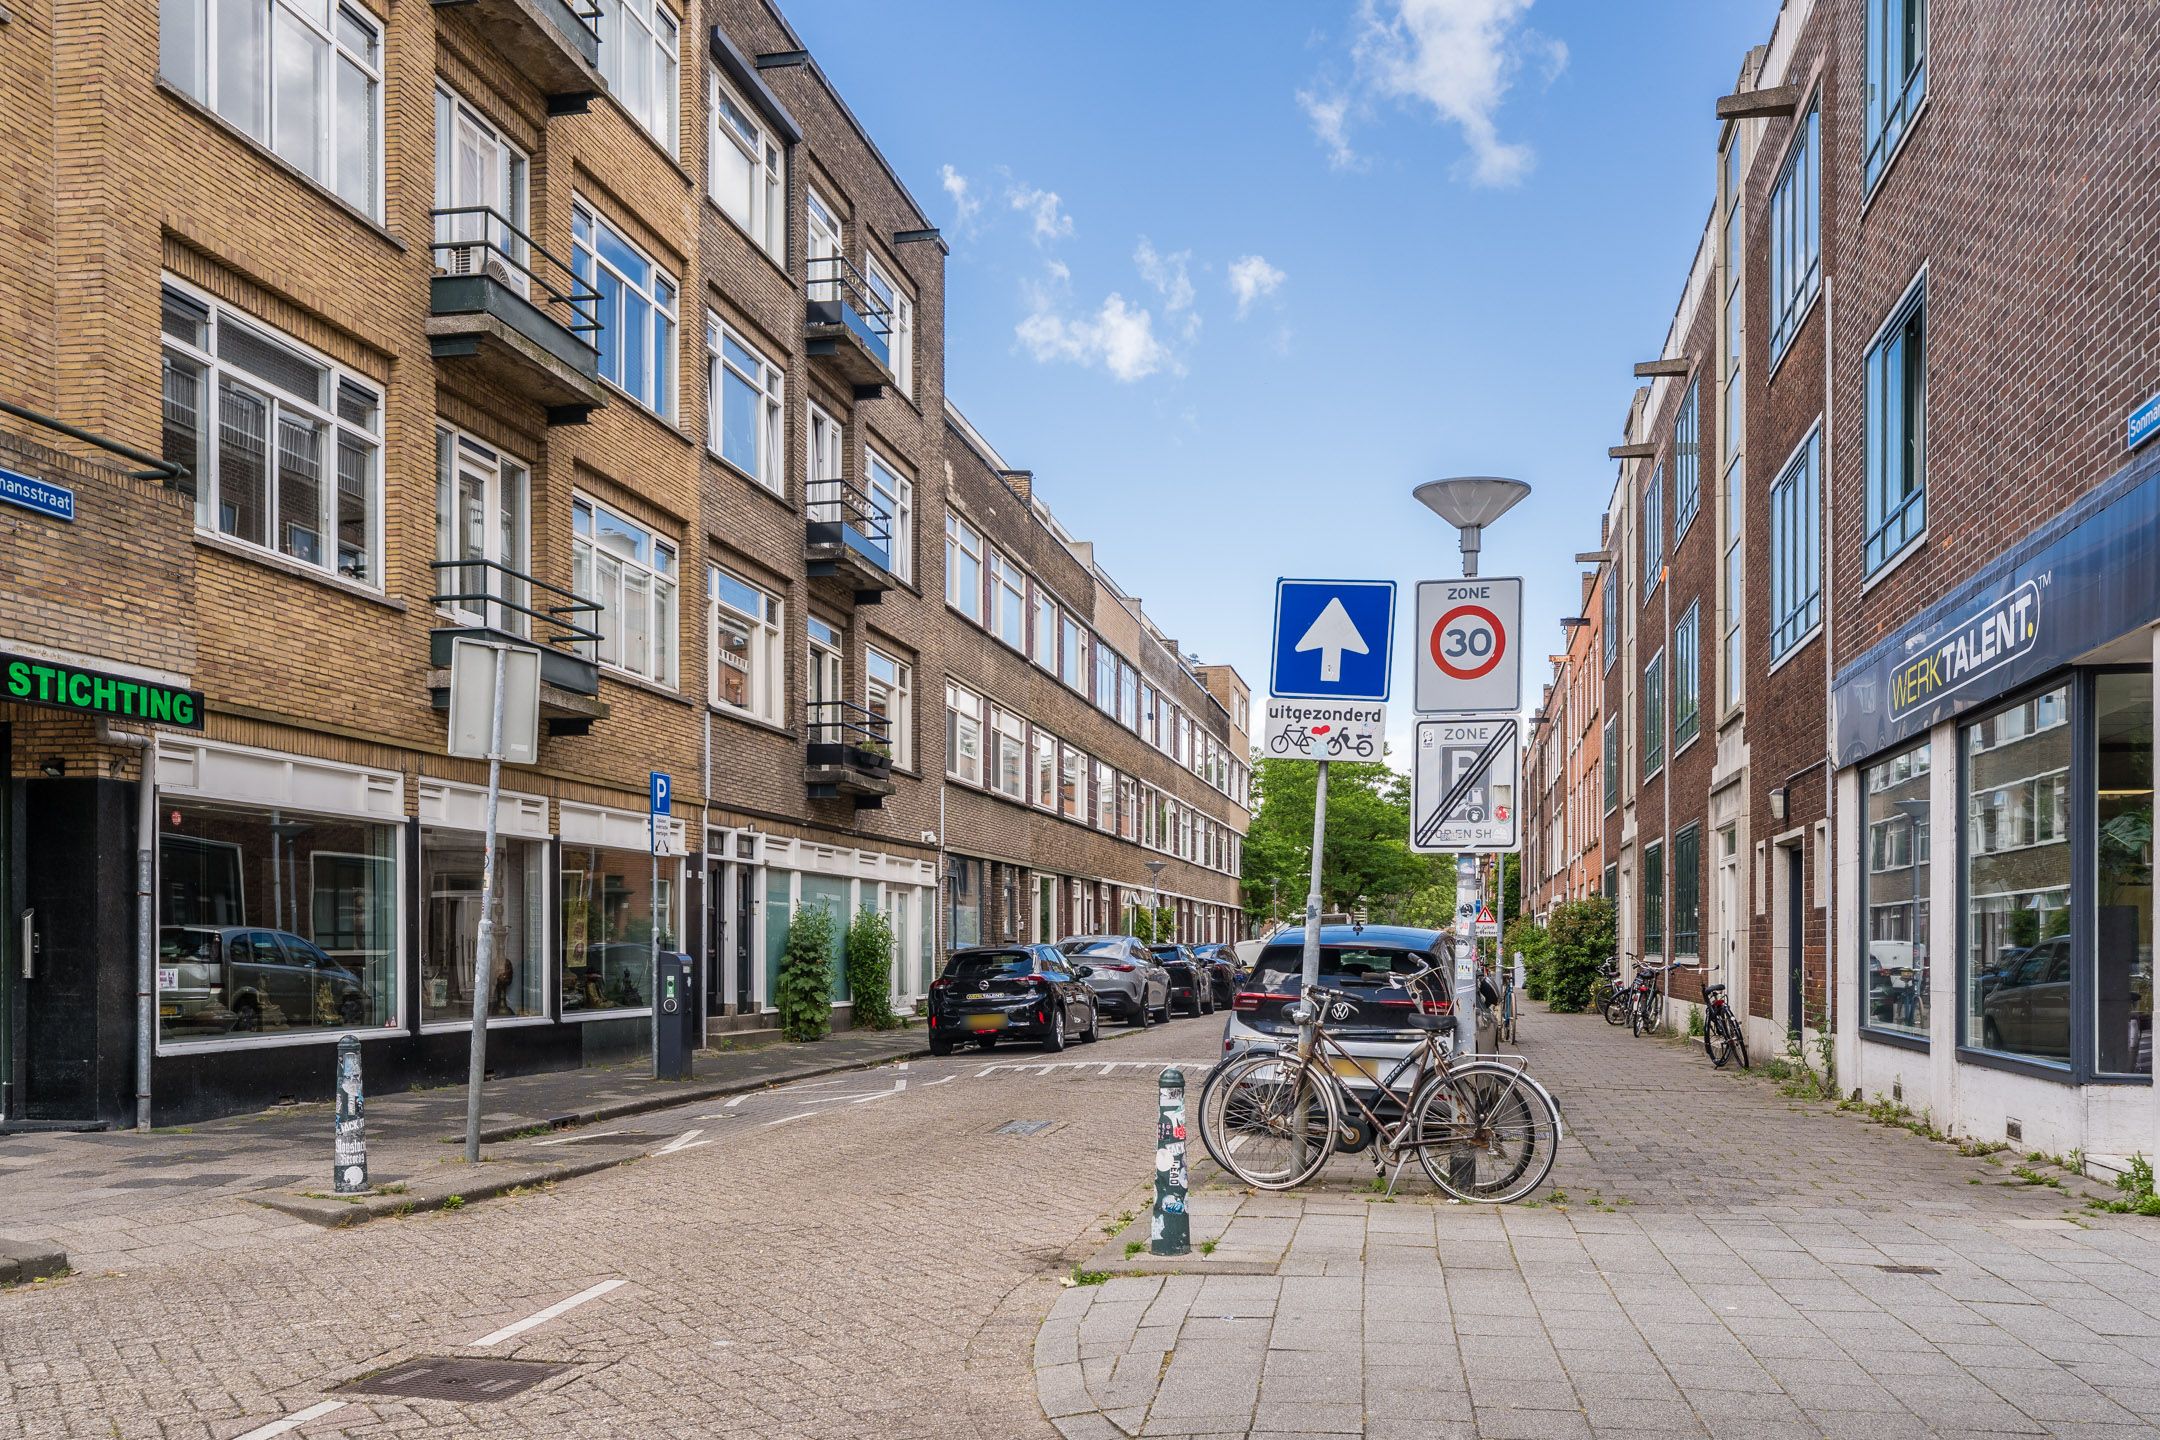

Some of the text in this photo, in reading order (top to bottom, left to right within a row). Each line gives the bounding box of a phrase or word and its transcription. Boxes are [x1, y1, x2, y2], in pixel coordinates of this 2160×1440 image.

[1447, 587, 1490, 600] ZONE
[1444, 627, 1493, 658] 30
[8, 662, 194, 724] STICHTING
[1269, 705, 1382, 724] uitgezonderd
[1444, 727, 1489, 740] ZONE
[656, 778, 667, 809] P
